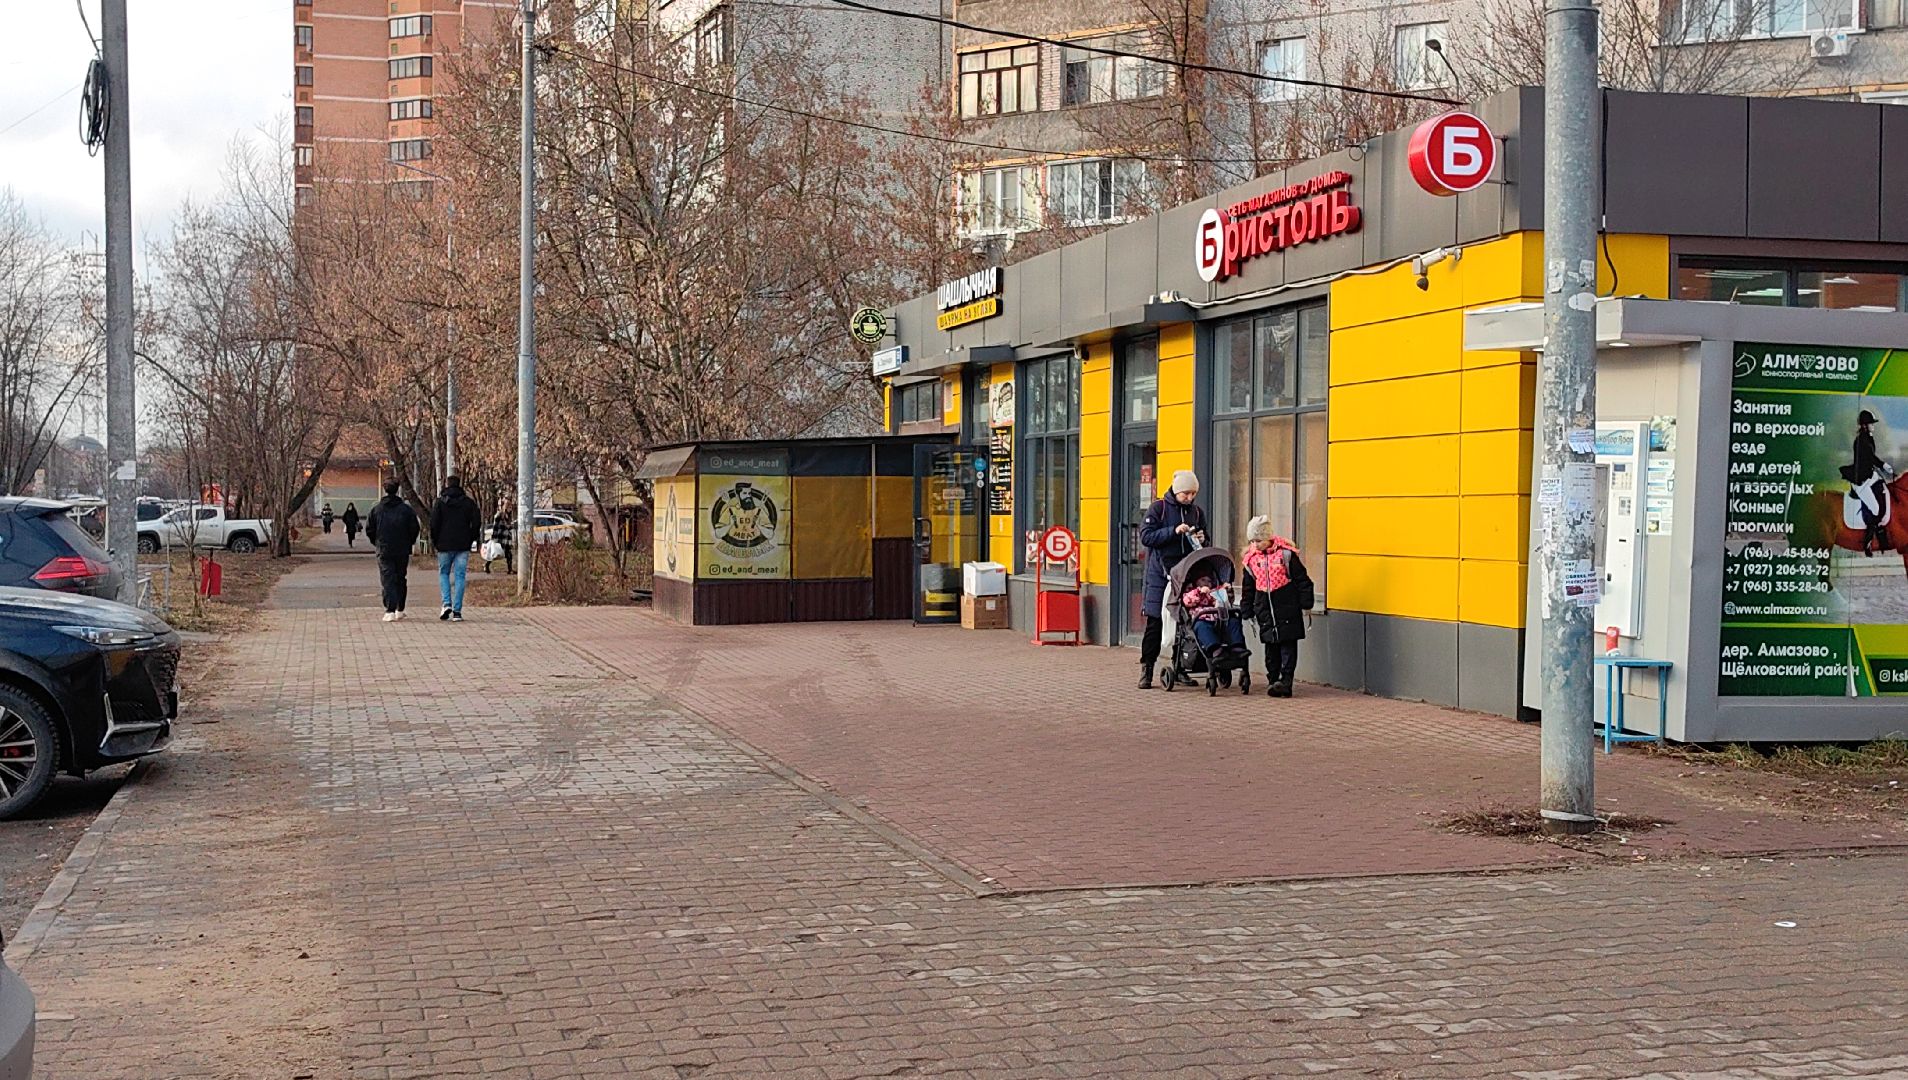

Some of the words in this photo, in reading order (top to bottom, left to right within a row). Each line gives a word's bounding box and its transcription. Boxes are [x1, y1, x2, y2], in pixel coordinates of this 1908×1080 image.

[1443, 126, 1483, 176] Б
[1227, 203, 1248, 217] СЕТЬ
[1248, 186, 1298, 212] МАГАЗИНОВ
[937, 266, 997, 311] ШАШЛЫЧНАЯ
[939, 311, 963, 328] ШАУРМА
[1761, 353, 1859, 372] АЛМЗОВО
[1761, 370, 1824, 380] конноспортивный
[1825, 372, 1858, 381] комплекс
[1733, 399, 1792, 416] Занятия
[1732, 422, 1751, 434] по
[1755, 422, 1825, 438] верховой
[1731, 443, 1767, 456] езде
[723, 458, 779, 469] ed_and_meat
[1730, 462, 1755, 475] для
[1758, 461, 1802, 476] детей
[1729, 482, 1740, 493] и
[1729, 499, 1785, 514] Конные
[733, 531, 756, 539] MEAT
[1052, 535, 1067, 552] Б
[1778, 547, 1830, 559] 45-88-66
[722, 565, 779, 576] ed_and_meat
[1726, 564, 1741, 575] +7
[1743, 564, 1773, 577] (927)
[1776, 564, 1829, 576] 206-93-72
[1726, 581, 1740, 592] +7
[1742, 581, 1772, 594] (968)
[1775, 581, 1829, 593] 335-28-40
[1735, 602, 1827, 615] www.almazovo.ru
[1721, 644, 1753, 660] дер.
[1757, 642, 1830, 657] Алмазово
[1721, 661, 1811, 677] Щёлковский
